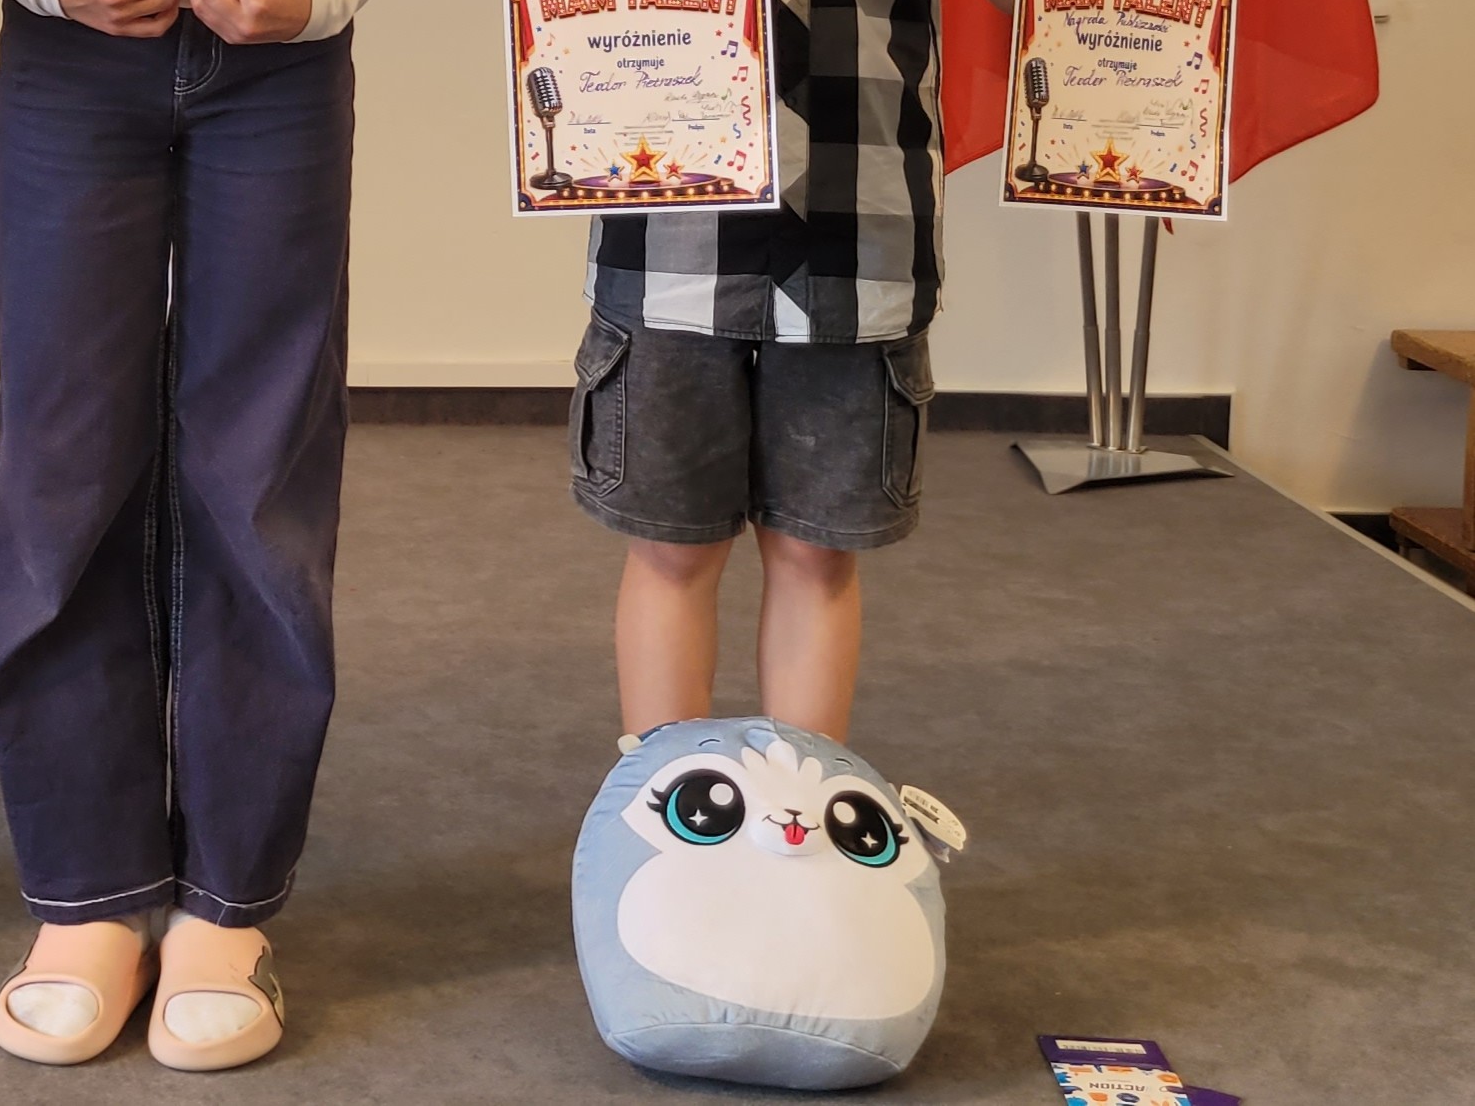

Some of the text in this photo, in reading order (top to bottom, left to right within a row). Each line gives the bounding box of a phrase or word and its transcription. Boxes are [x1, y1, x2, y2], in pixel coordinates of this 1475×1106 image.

[587, 28, 692, 54] wyróżnienie
[1077, 29, 1163, 52] wyróżnienie
[616, 56, 665, 71] otrzymuje
[1097, 57, 1138, 73] otrzymuje
[1090, 1083, 1145, 1092] ACTION
